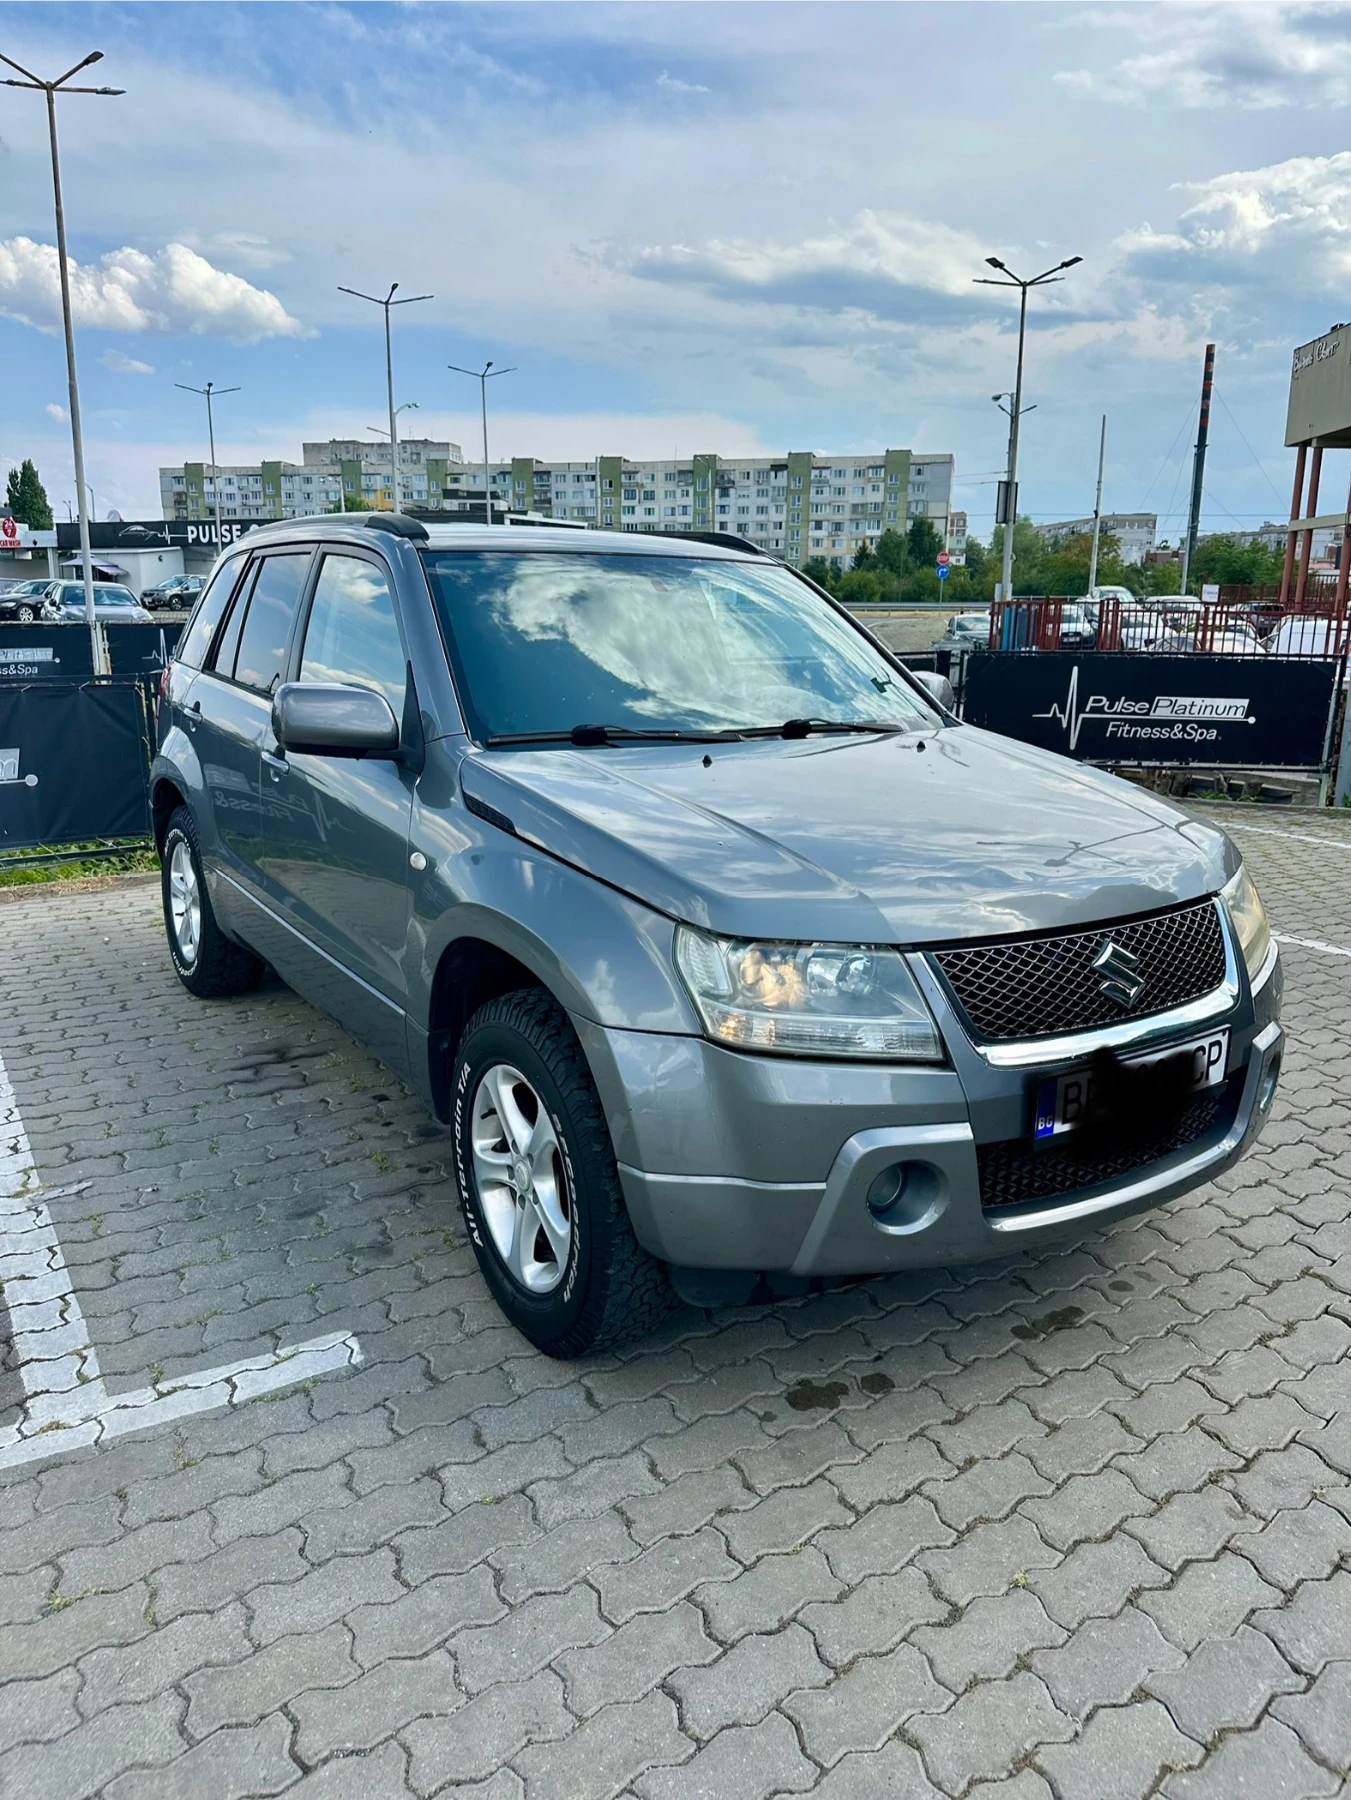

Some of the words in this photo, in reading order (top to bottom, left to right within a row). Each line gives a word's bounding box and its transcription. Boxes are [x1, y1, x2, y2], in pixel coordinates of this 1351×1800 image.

[187, 524, 242, 543] PULSE
[1085, 695, 1150, 714] Pulse
[1152, 698, 1246, 717] Platinum
[1106, 721, 1218, 742] Fitness&Spa
[458, 1062, 471, 1094] T/A
[1038, 1115, 1053, 1131] BG
[454, 1098, 483, 1247] All-Terrain
